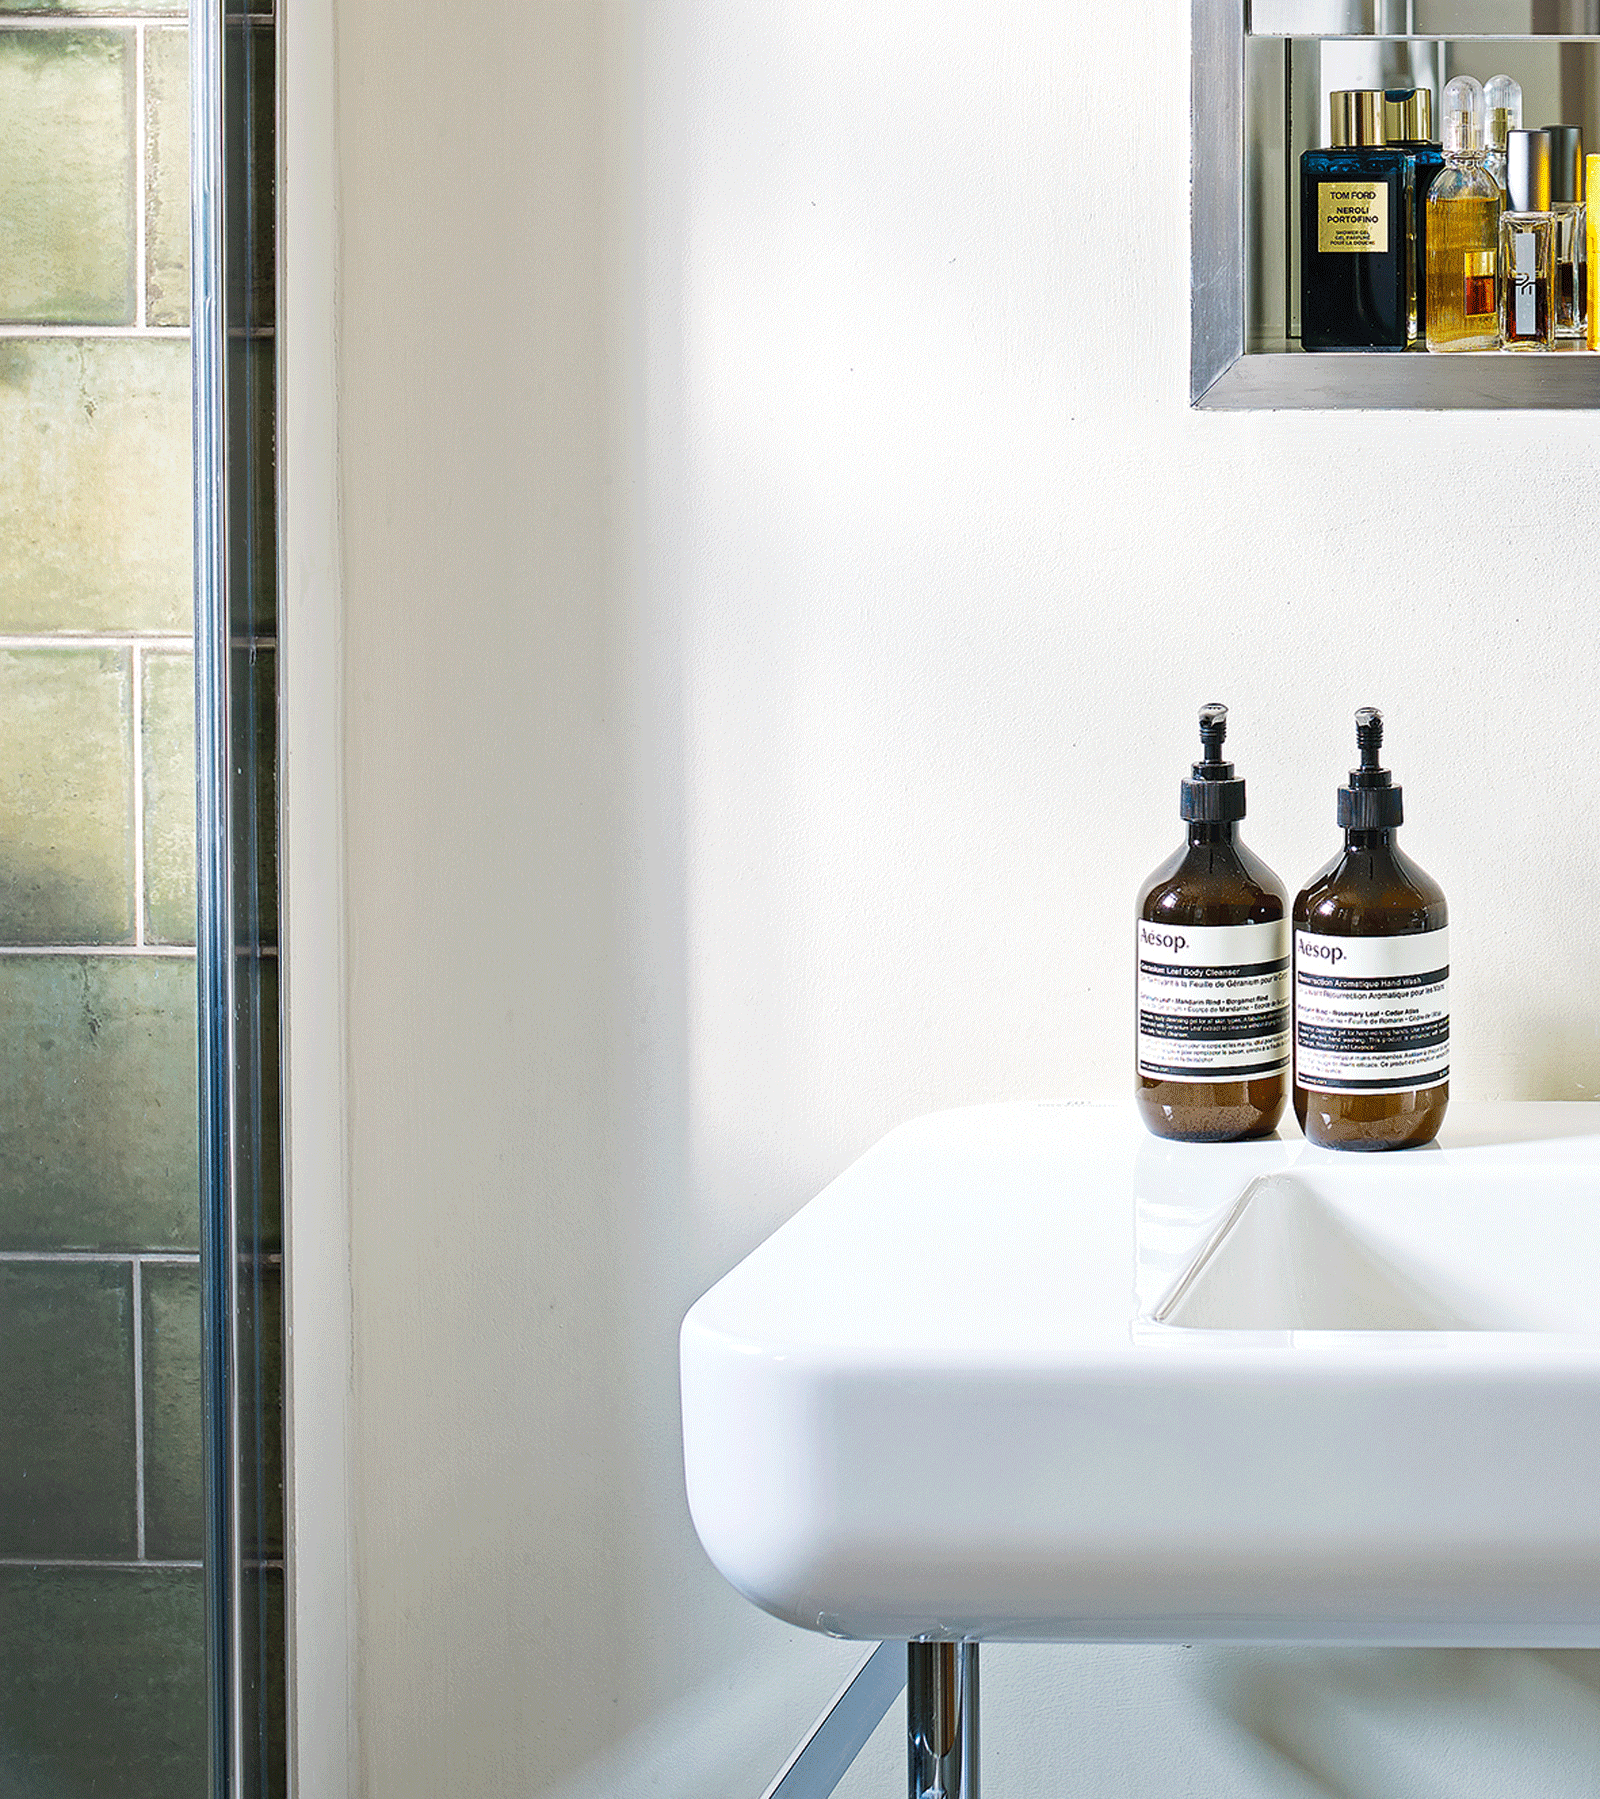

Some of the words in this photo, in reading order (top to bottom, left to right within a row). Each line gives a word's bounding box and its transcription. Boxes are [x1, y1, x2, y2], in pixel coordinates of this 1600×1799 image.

[1330, 191, 1350, 199] TOM
[1351, 191, 1376, 199] FORD
[1183, 968, 1203, 978] Body
[1205, 968, 1241, 976] Cleanser
[1334, 978, 1380, 989] Aromatique
[1381, 978, 1401, 986] Hand
[1368, 991, 1409, 1000] Aromatique
